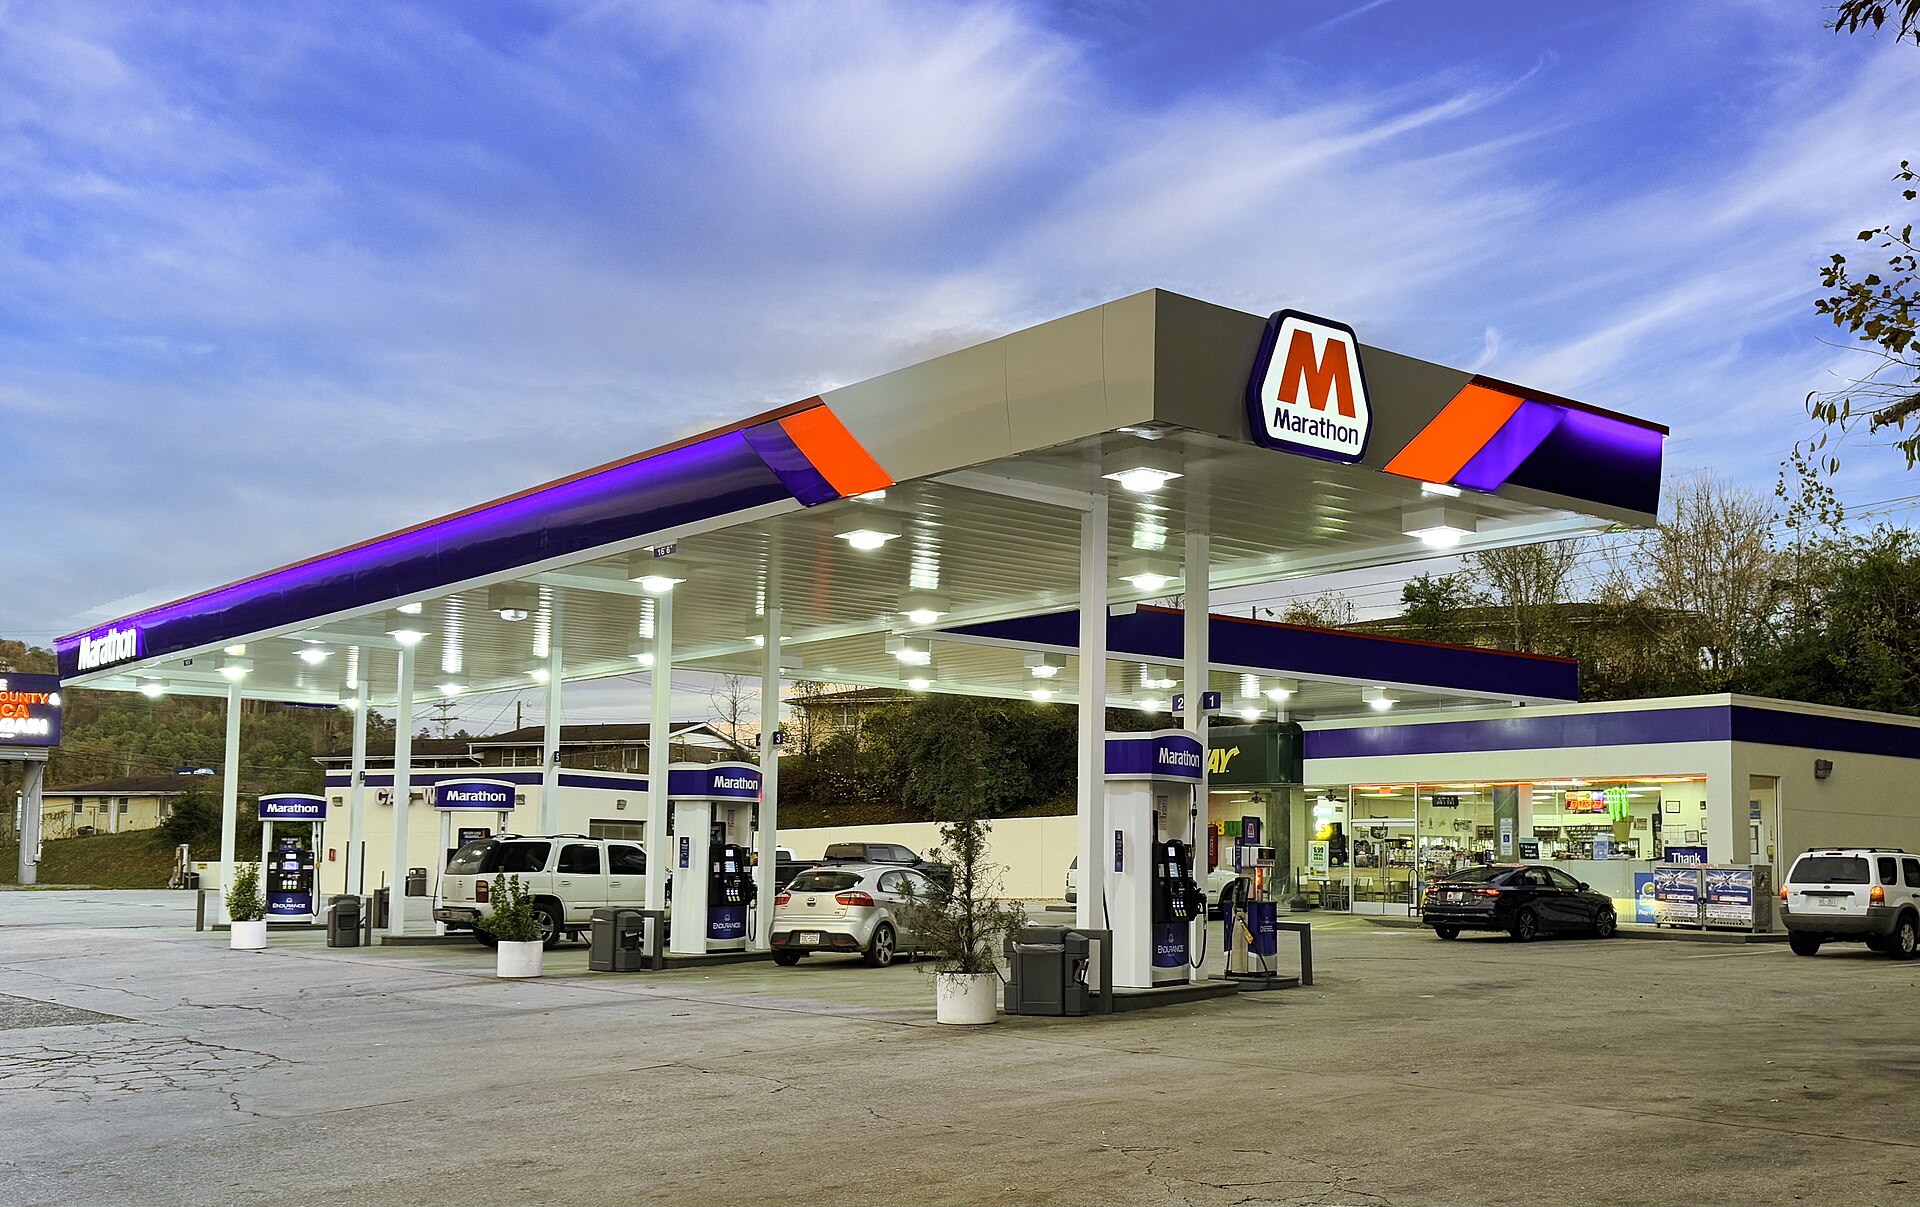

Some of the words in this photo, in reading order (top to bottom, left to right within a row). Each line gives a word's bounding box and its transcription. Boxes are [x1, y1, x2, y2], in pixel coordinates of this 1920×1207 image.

[1277, 329, 1356, 418] M
[1273, 406, 1359, 446] Marathon
[77, 627, 137, 671] Marathon
[1177, 697, 1184, 709] 2
[1208, 694, 1215, 708] 1
[775, 733, 781, 744] 3
[555, 752, 560, 761] 5
[1158, 747, 1200, 768] Marathon
[713, 775, 758, 790] Marathon
[446, 790, 507, 802] Marathon
[1436, 797, 1455, 806] ATM
[266, 803, 319, 814] Marathon
[1671, 852, 1701, 864] Thank
[1157, 945, 1185, 954] ENDURANCE
